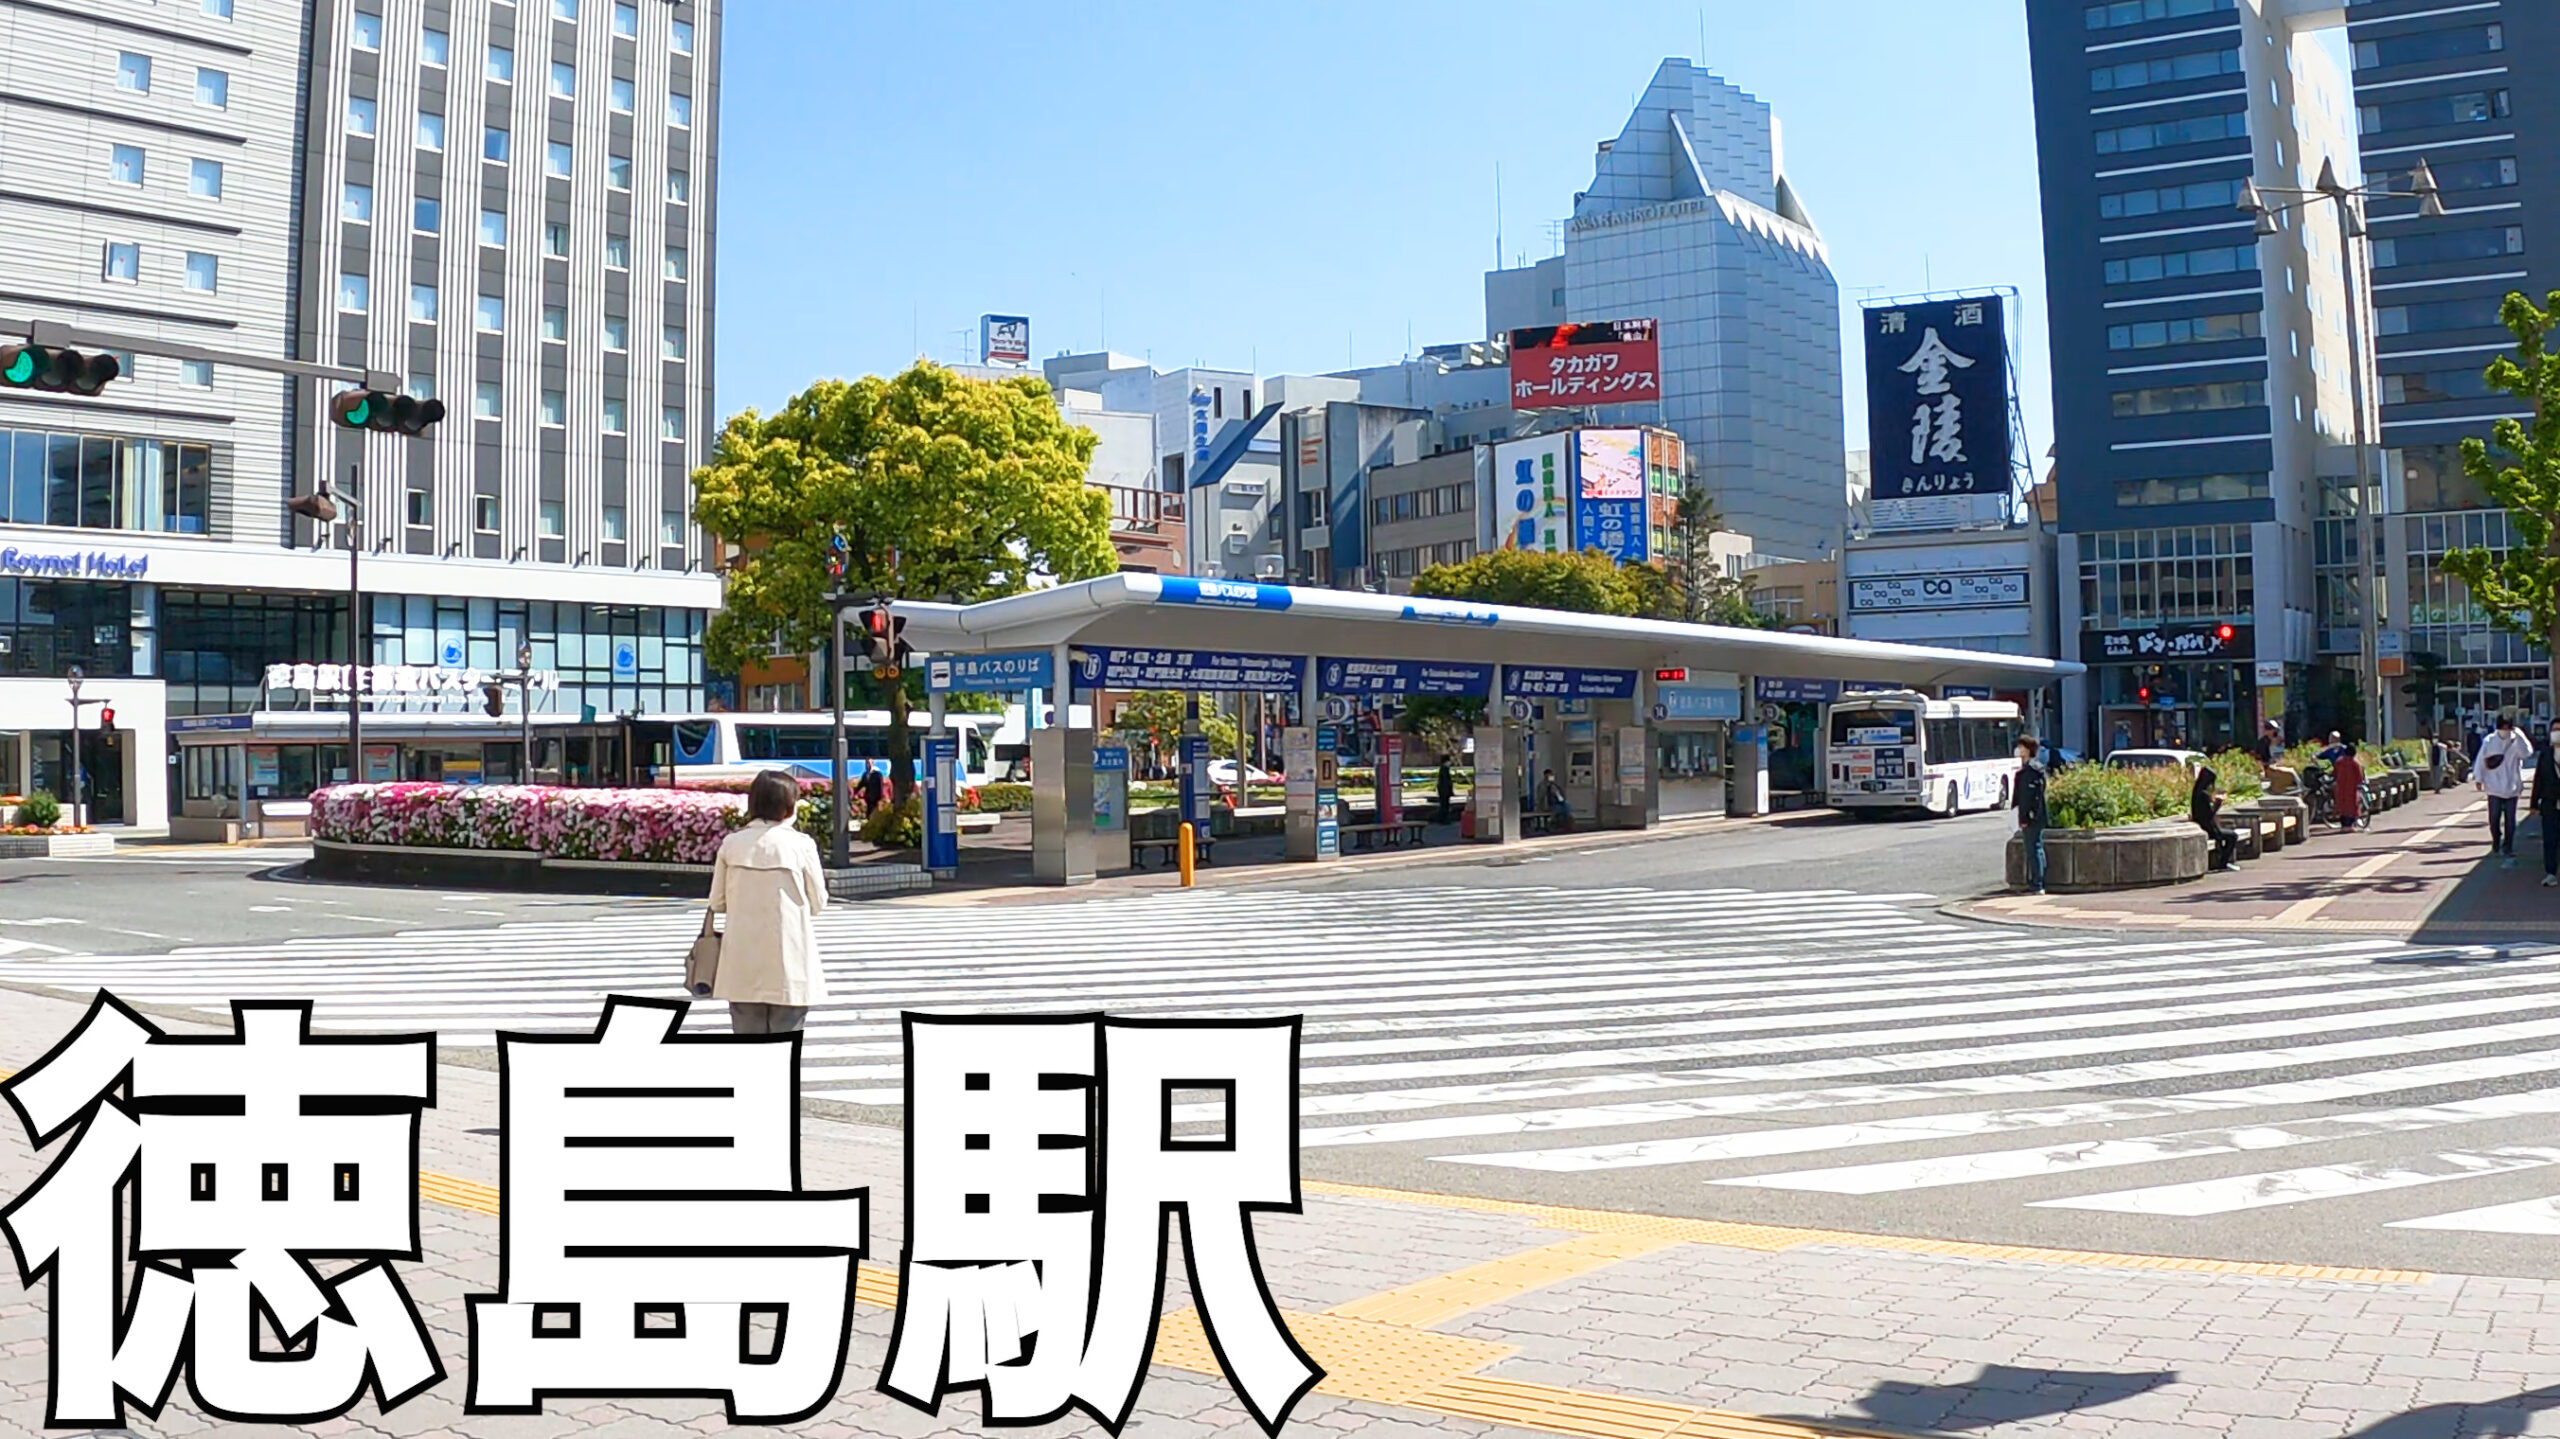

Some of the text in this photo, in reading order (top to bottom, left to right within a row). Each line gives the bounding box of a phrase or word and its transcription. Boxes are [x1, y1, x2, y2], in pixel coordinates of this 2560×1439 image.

[1549, 353, 1619, 376] タカガワ
[1514, 372, 1656, 398] ホールディングス
[1901, 472, 1975, 494] きんりょう
[85, 551, 148, 579] Hotel
[955, 658, 1040, 676] 徳島バスのりば
